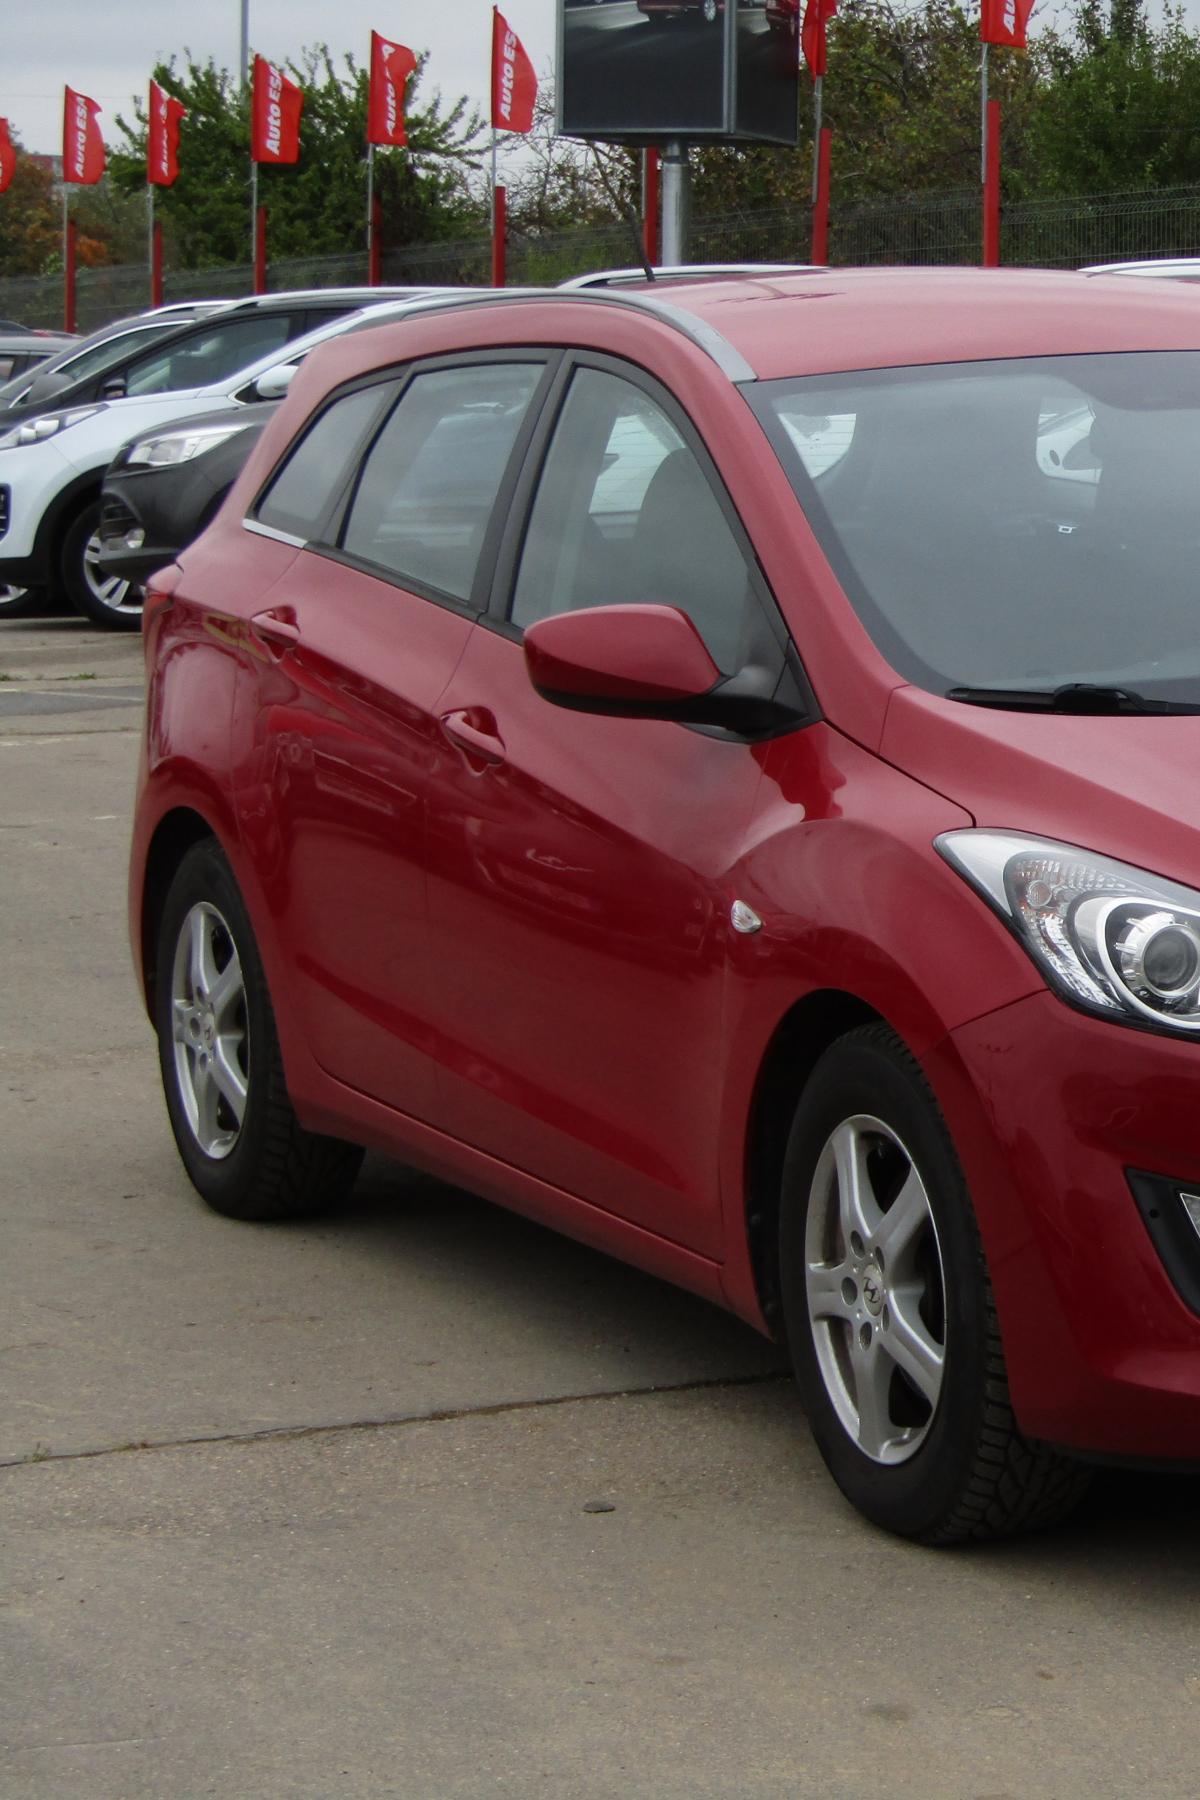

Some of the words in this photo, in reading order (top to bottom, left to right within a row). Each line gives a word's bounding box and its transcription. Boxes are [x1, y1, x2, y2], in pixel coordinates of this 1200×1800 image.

[386, 82, 396, 137] Auto
[500, 62, 514, 121] Auto
[75, 131, 86, 178] Auto
[265, 103, 281, 156] Auto
